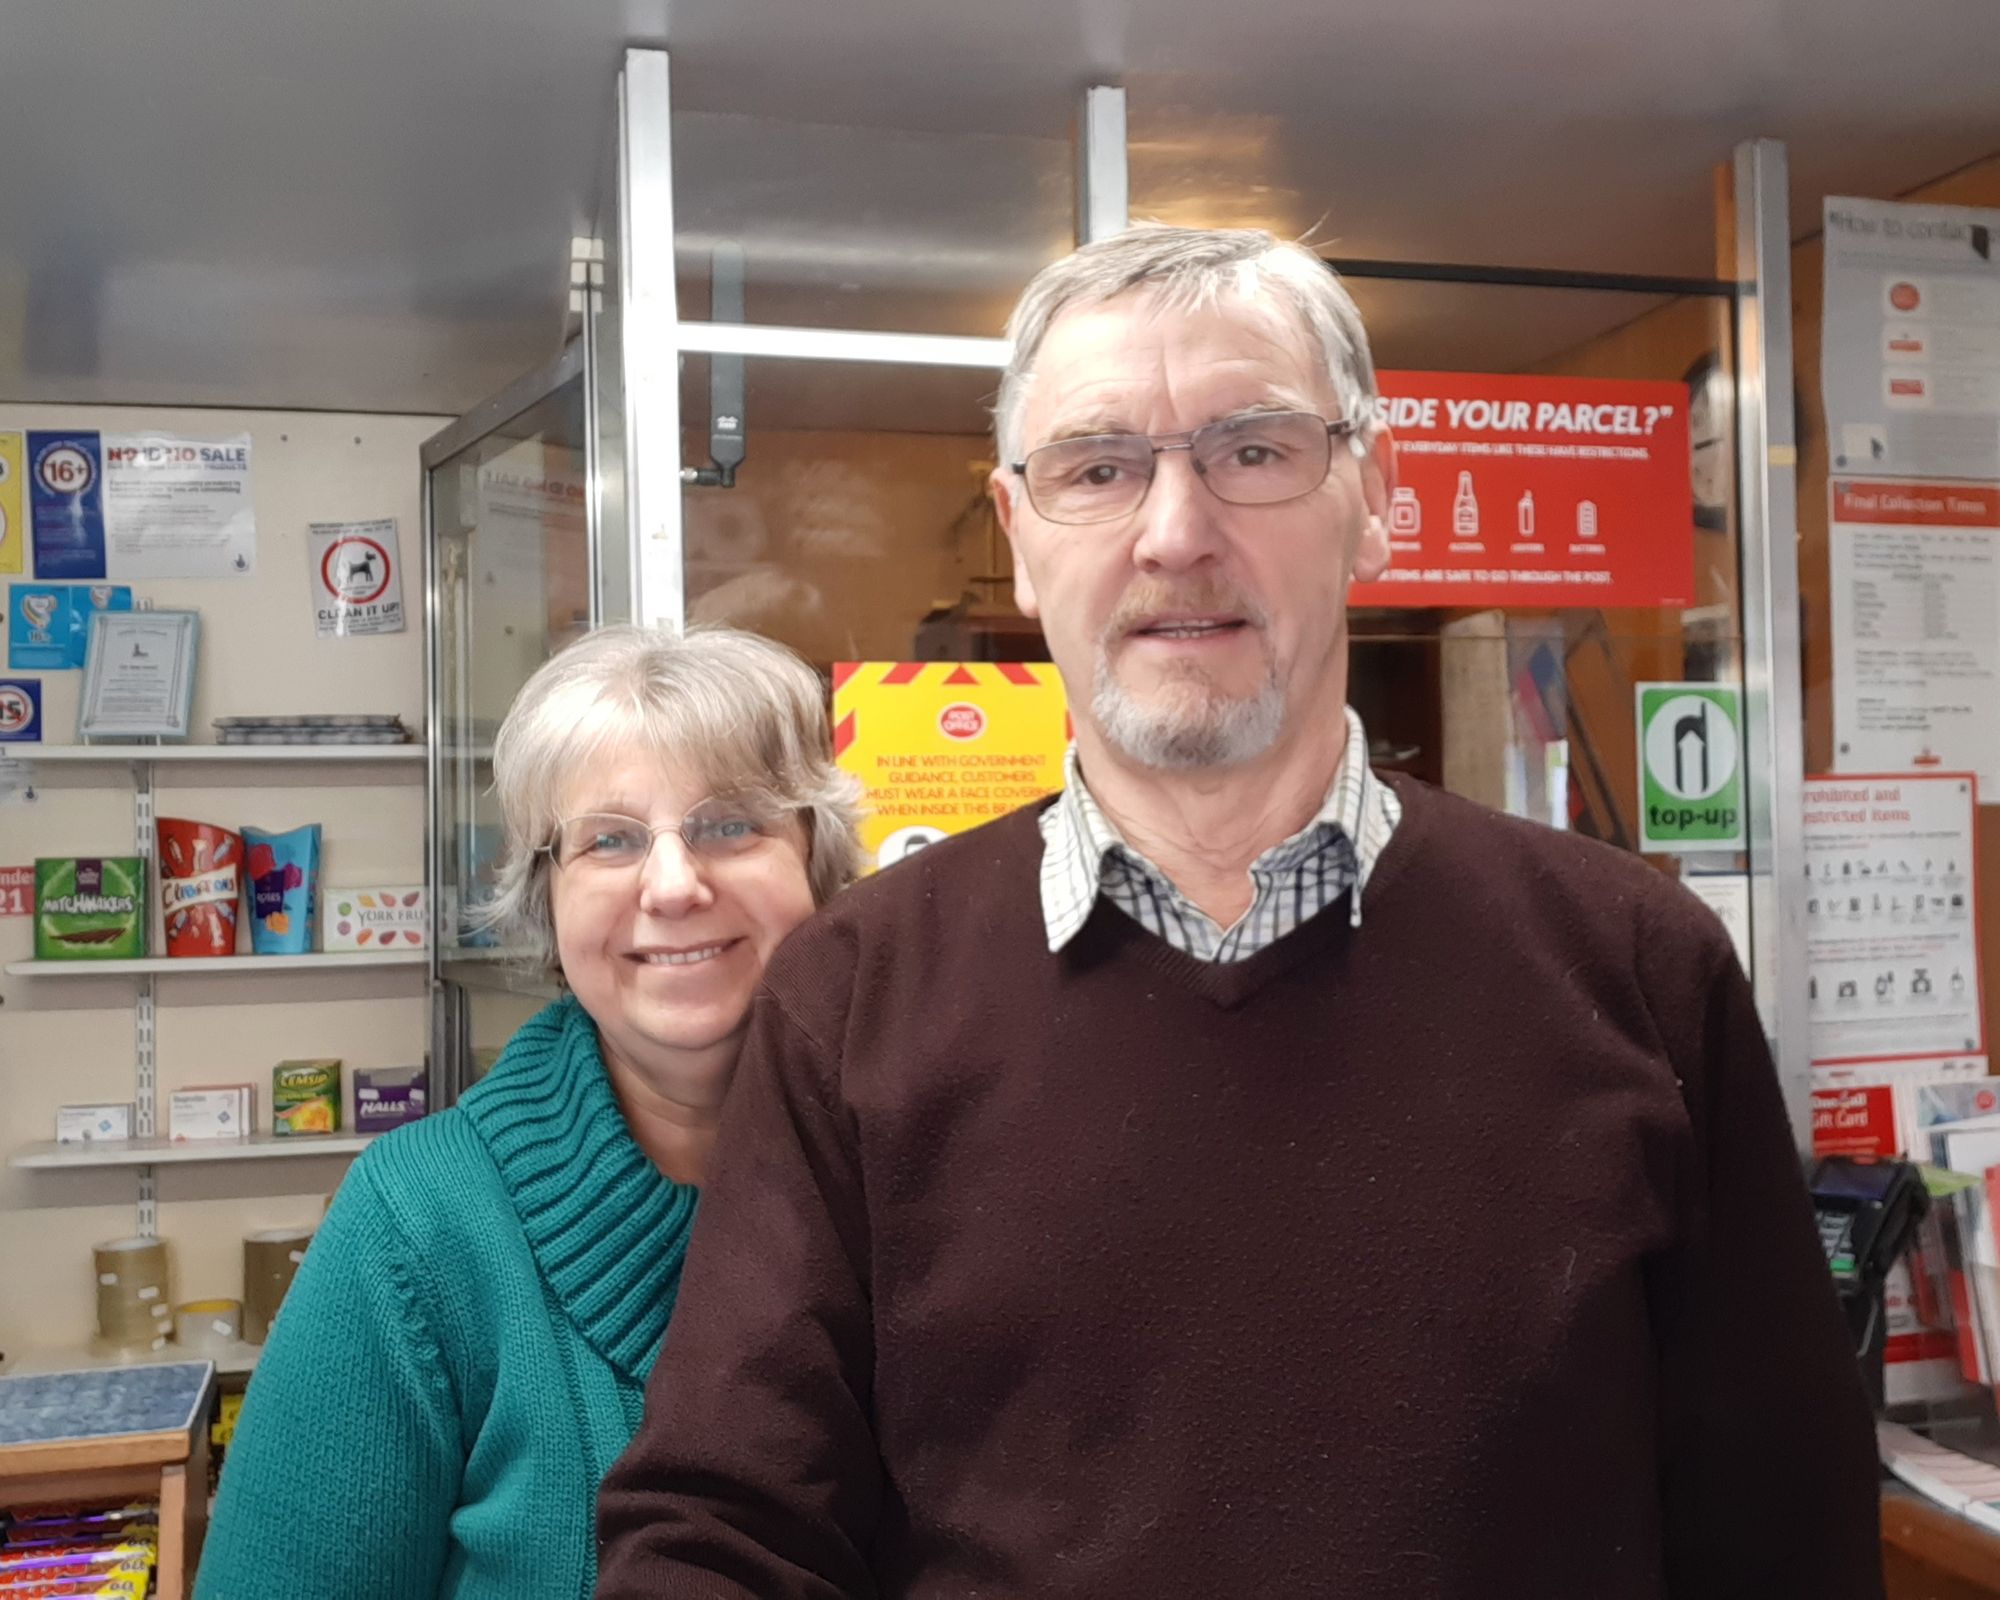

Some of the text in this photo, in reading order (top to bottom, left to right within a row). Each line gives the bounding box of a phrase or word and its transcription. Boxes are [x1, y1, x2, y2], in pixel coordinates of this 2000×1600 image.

[1375, 396, 1674, 436] SIDE YOUR PARCEL?"
[200, 448, 246, 463] SALE
[46, 459, 87, 483] 16+
[318, 606, 362, 620] CLAN
[366, 605, 377, 616] IT
[877, 754, 1047, 767] IN LINE WITH GOVERNMENT
[961, 771, 1036, 783] CUSTOMERS
[867, 788, 900, 799] MUST
[905, 788, 945, 799] WEAR
[947, 788, 958, 799] A
[960, 787, 989, 799] FACE
[1804, 786, 1869, 803] rohibited
[877, 802, 1017, 816] WHEN INSIDE THIS BRA
[1804, 807, 1866, 823] estricted
[1650, 805, 1737, 830] top-up
[0, 867, 35, 886] nder
[358, 910, 423, 927] YORK FRU
[360, 1100, 406, 1114] HALLS
